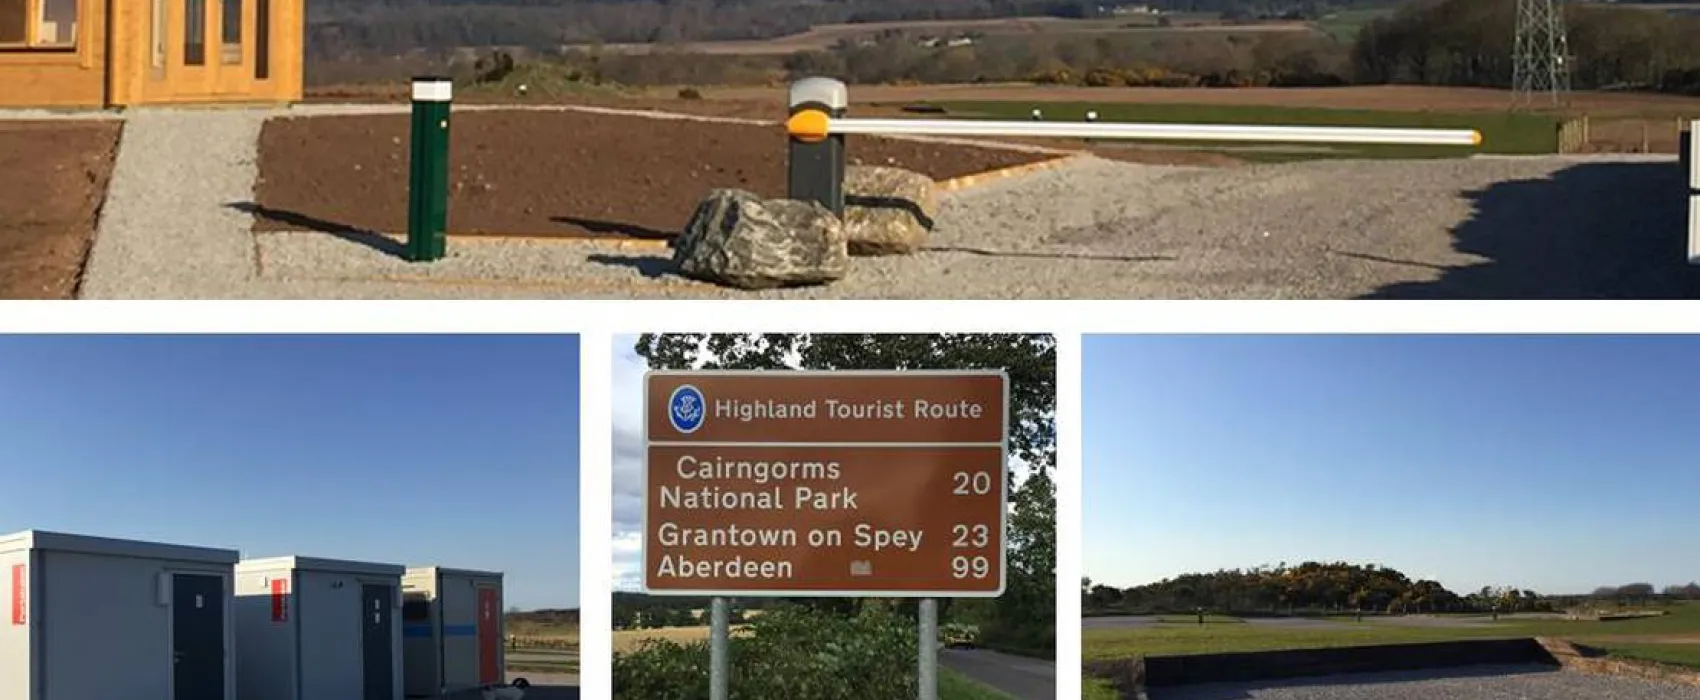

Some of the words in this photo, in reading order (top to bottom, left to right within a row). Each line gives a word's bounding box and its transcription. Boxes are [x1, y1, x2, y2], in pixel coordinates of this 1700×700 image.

[716, 399, 816, 422] Highland
[825, 400, 904, 418] Tourist
[915, 400, 982, 418] Route
[677, 455, 840, 483] Cairngorms
[953, 472, 990, 494] 20
[660, 486, 783, 508] National
[795, 486, 857, 508] Park
[658, 523, 796, 546] Grantown
[808, 529, 842, 546] on
[855, 524, 923, 551] Spey
[953, 524, 988, 546] 23
[657, 556, 792, 578] Aberdeen
[952, 556, 989, 578] 99
